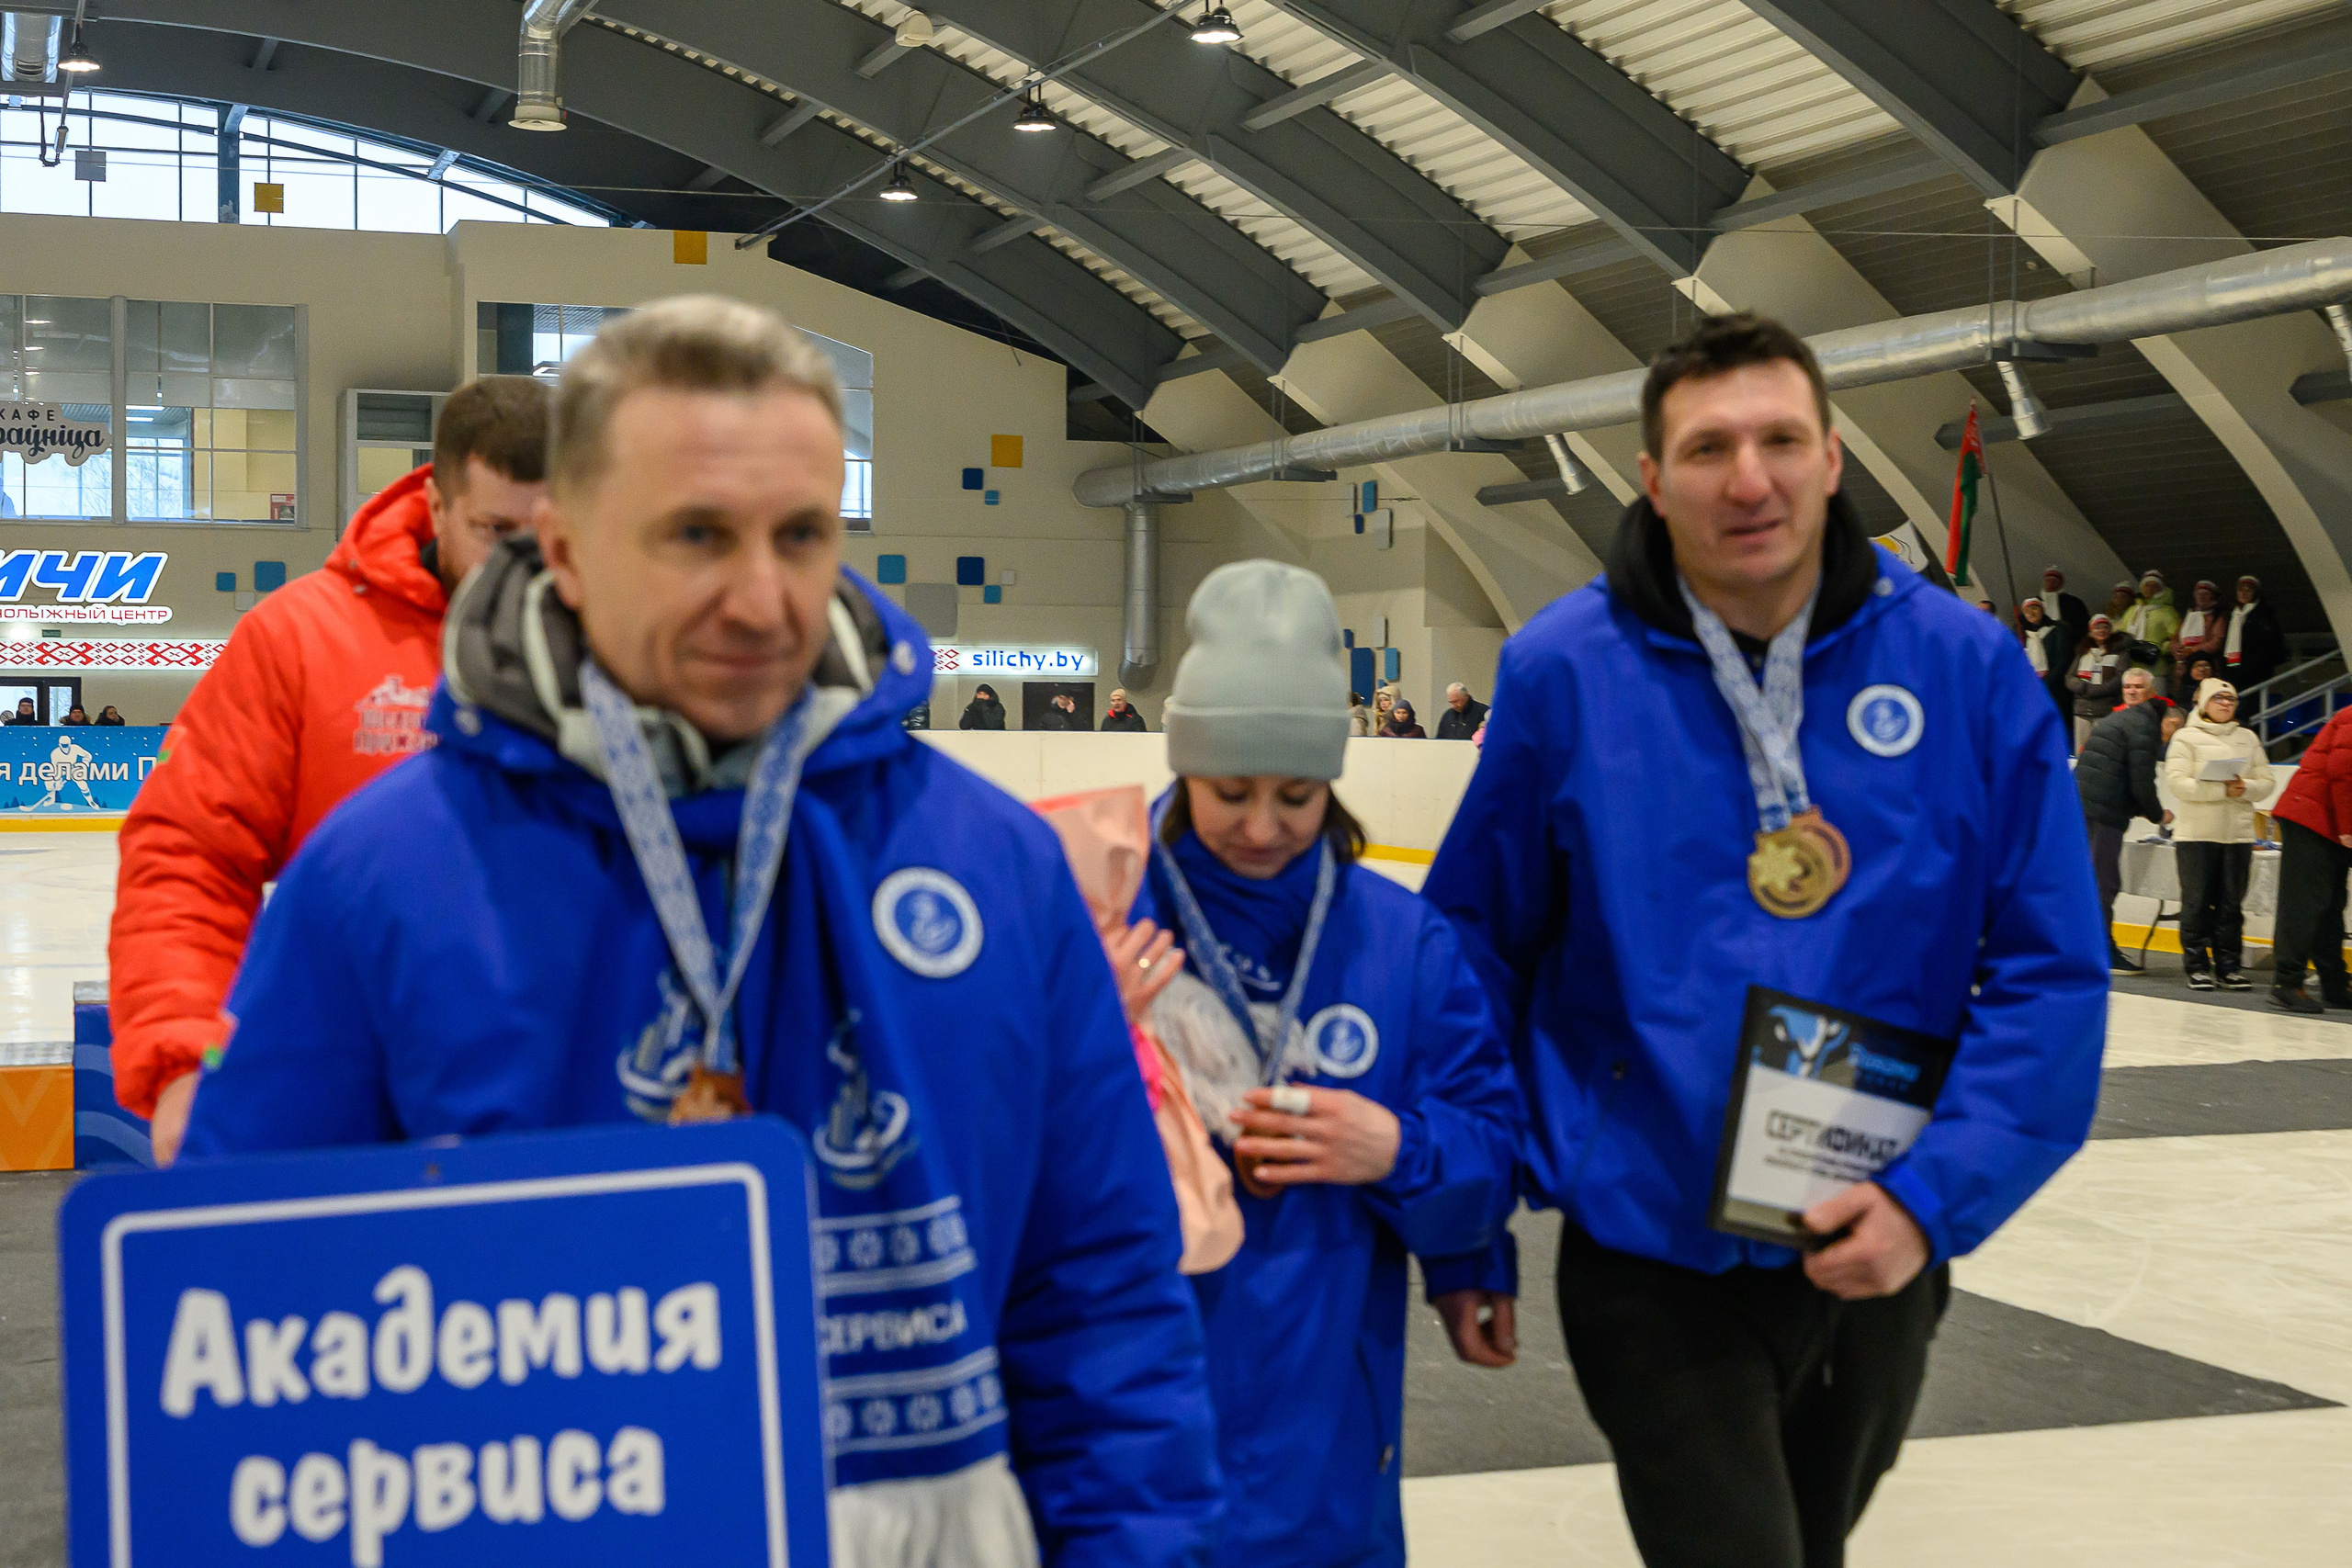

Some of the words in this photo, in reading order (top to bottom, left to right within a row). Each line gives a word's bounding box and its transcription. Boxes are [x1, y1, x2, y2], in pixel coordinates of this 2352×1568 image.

[111, 610, 168, 622] ЦЕНТР
[972, 649, 1084, 671] silichy.by
[17, 761, 130, 786] делами
[158, 1263, 724, 1419] Академия
[228, 1425, 666, 1568] сервиса
